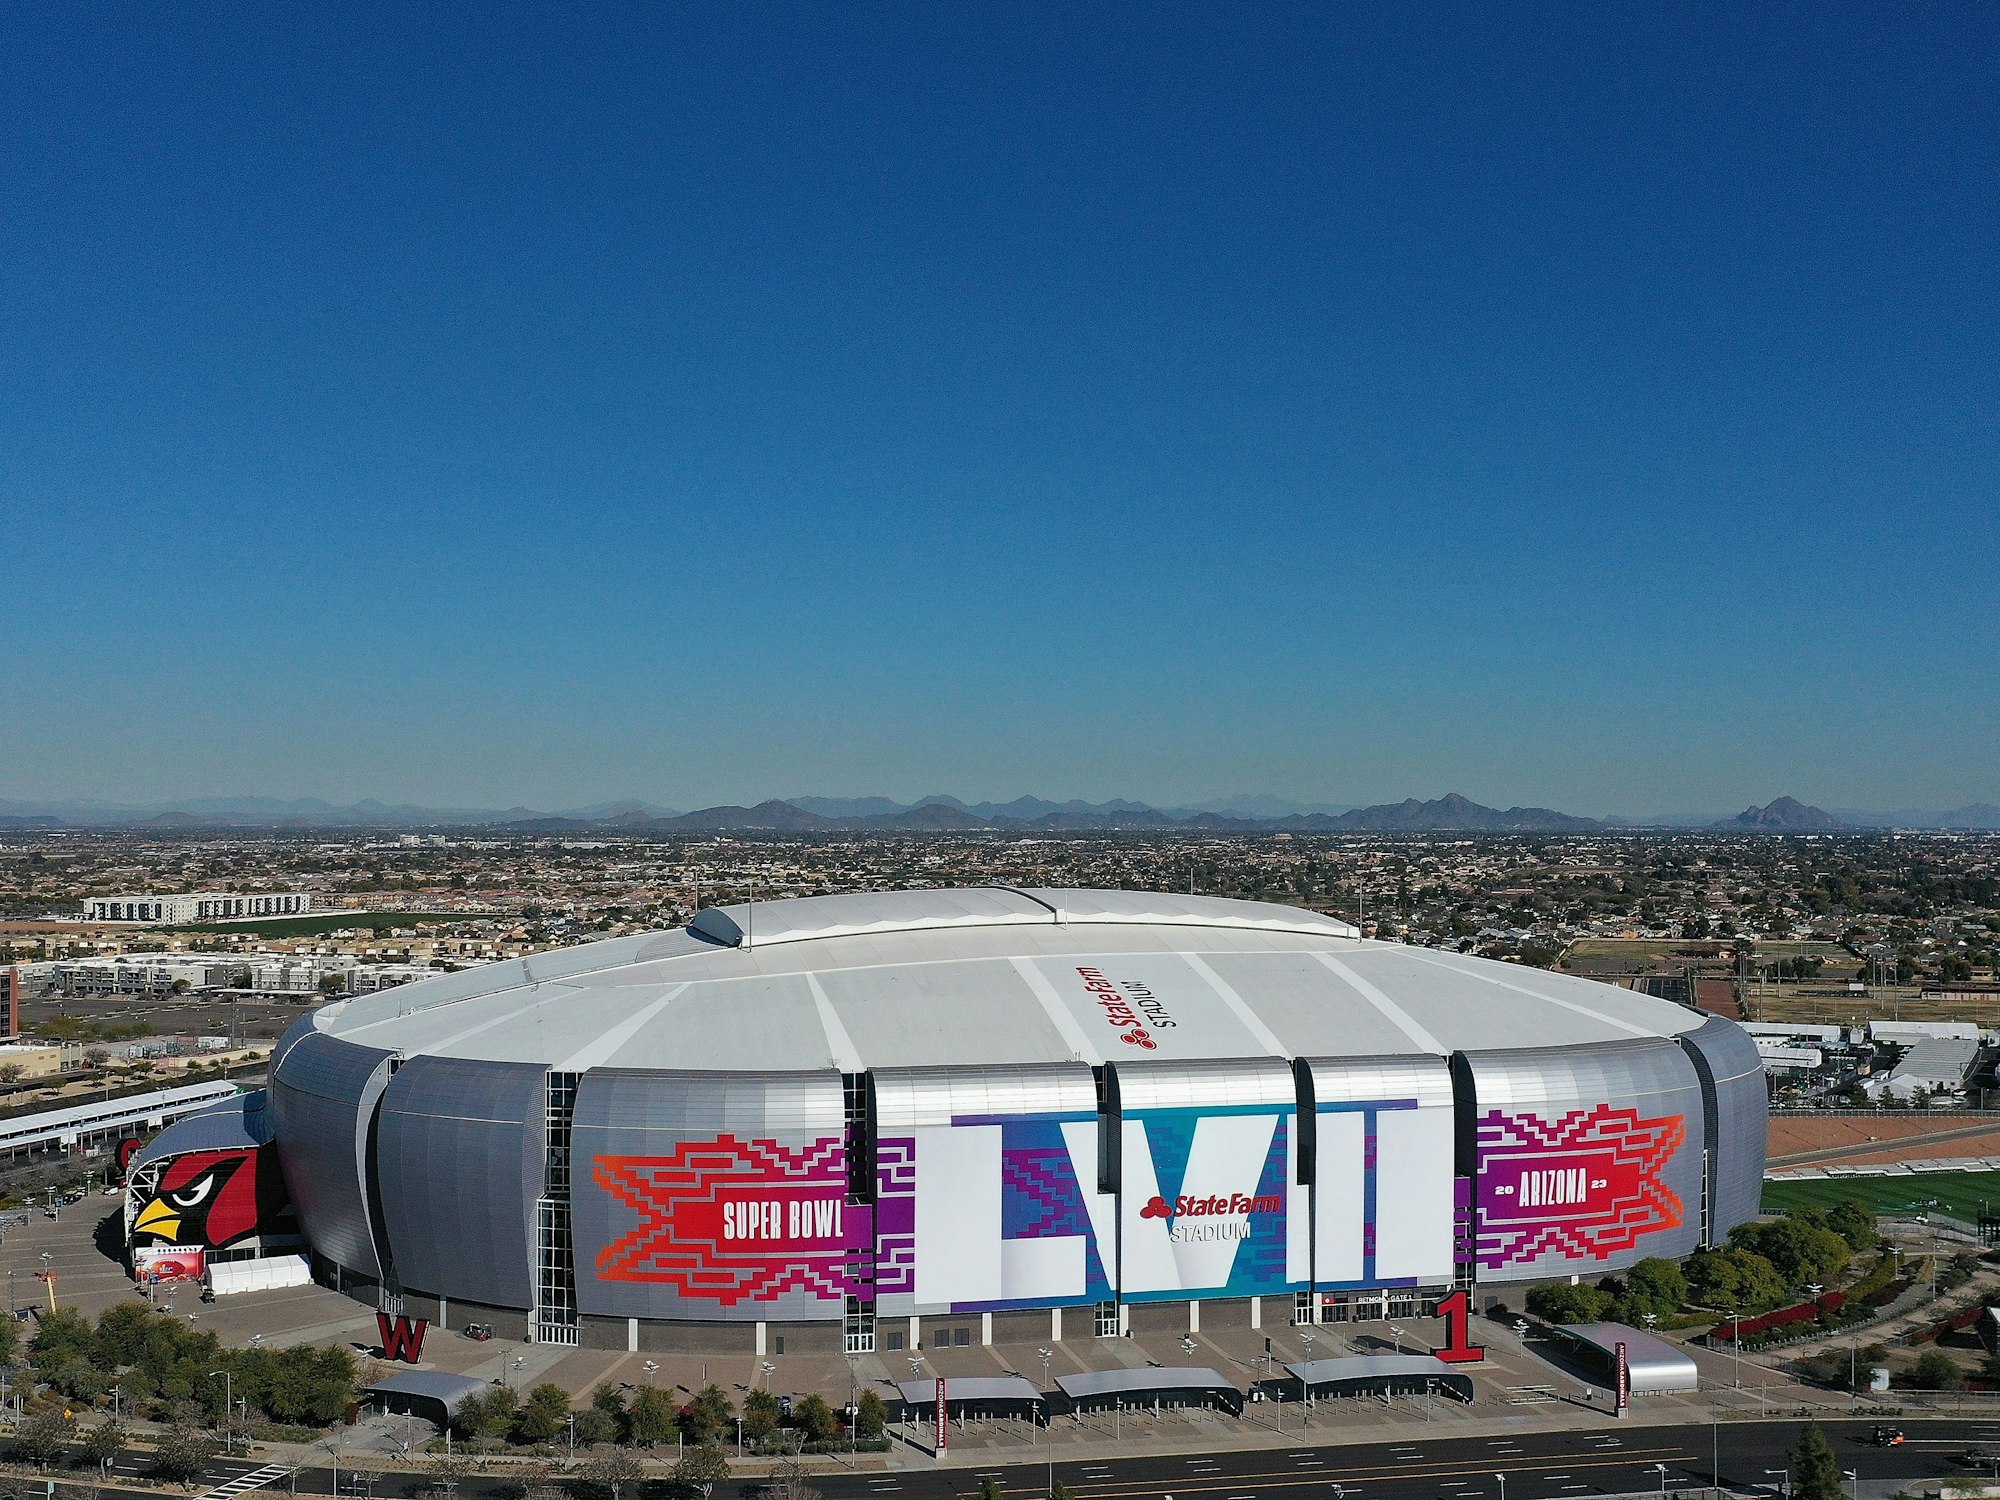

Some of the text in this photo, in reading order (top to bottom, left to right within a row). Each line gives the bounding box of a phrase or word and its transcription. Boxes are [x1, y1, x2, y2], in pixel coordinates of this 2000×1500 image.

[1120, 980, 1177, 1028] STADIUM
[1494, 1167, 1607, 1207] 20 ARIZONA 23
[723, 1199, 844, 1239] SUPER BOWL
[1170, 1221, 1250, 1243] STADIUM
[376, 1312, 430, 1364] W
[1430, 1288, 1485, 1364] 1
